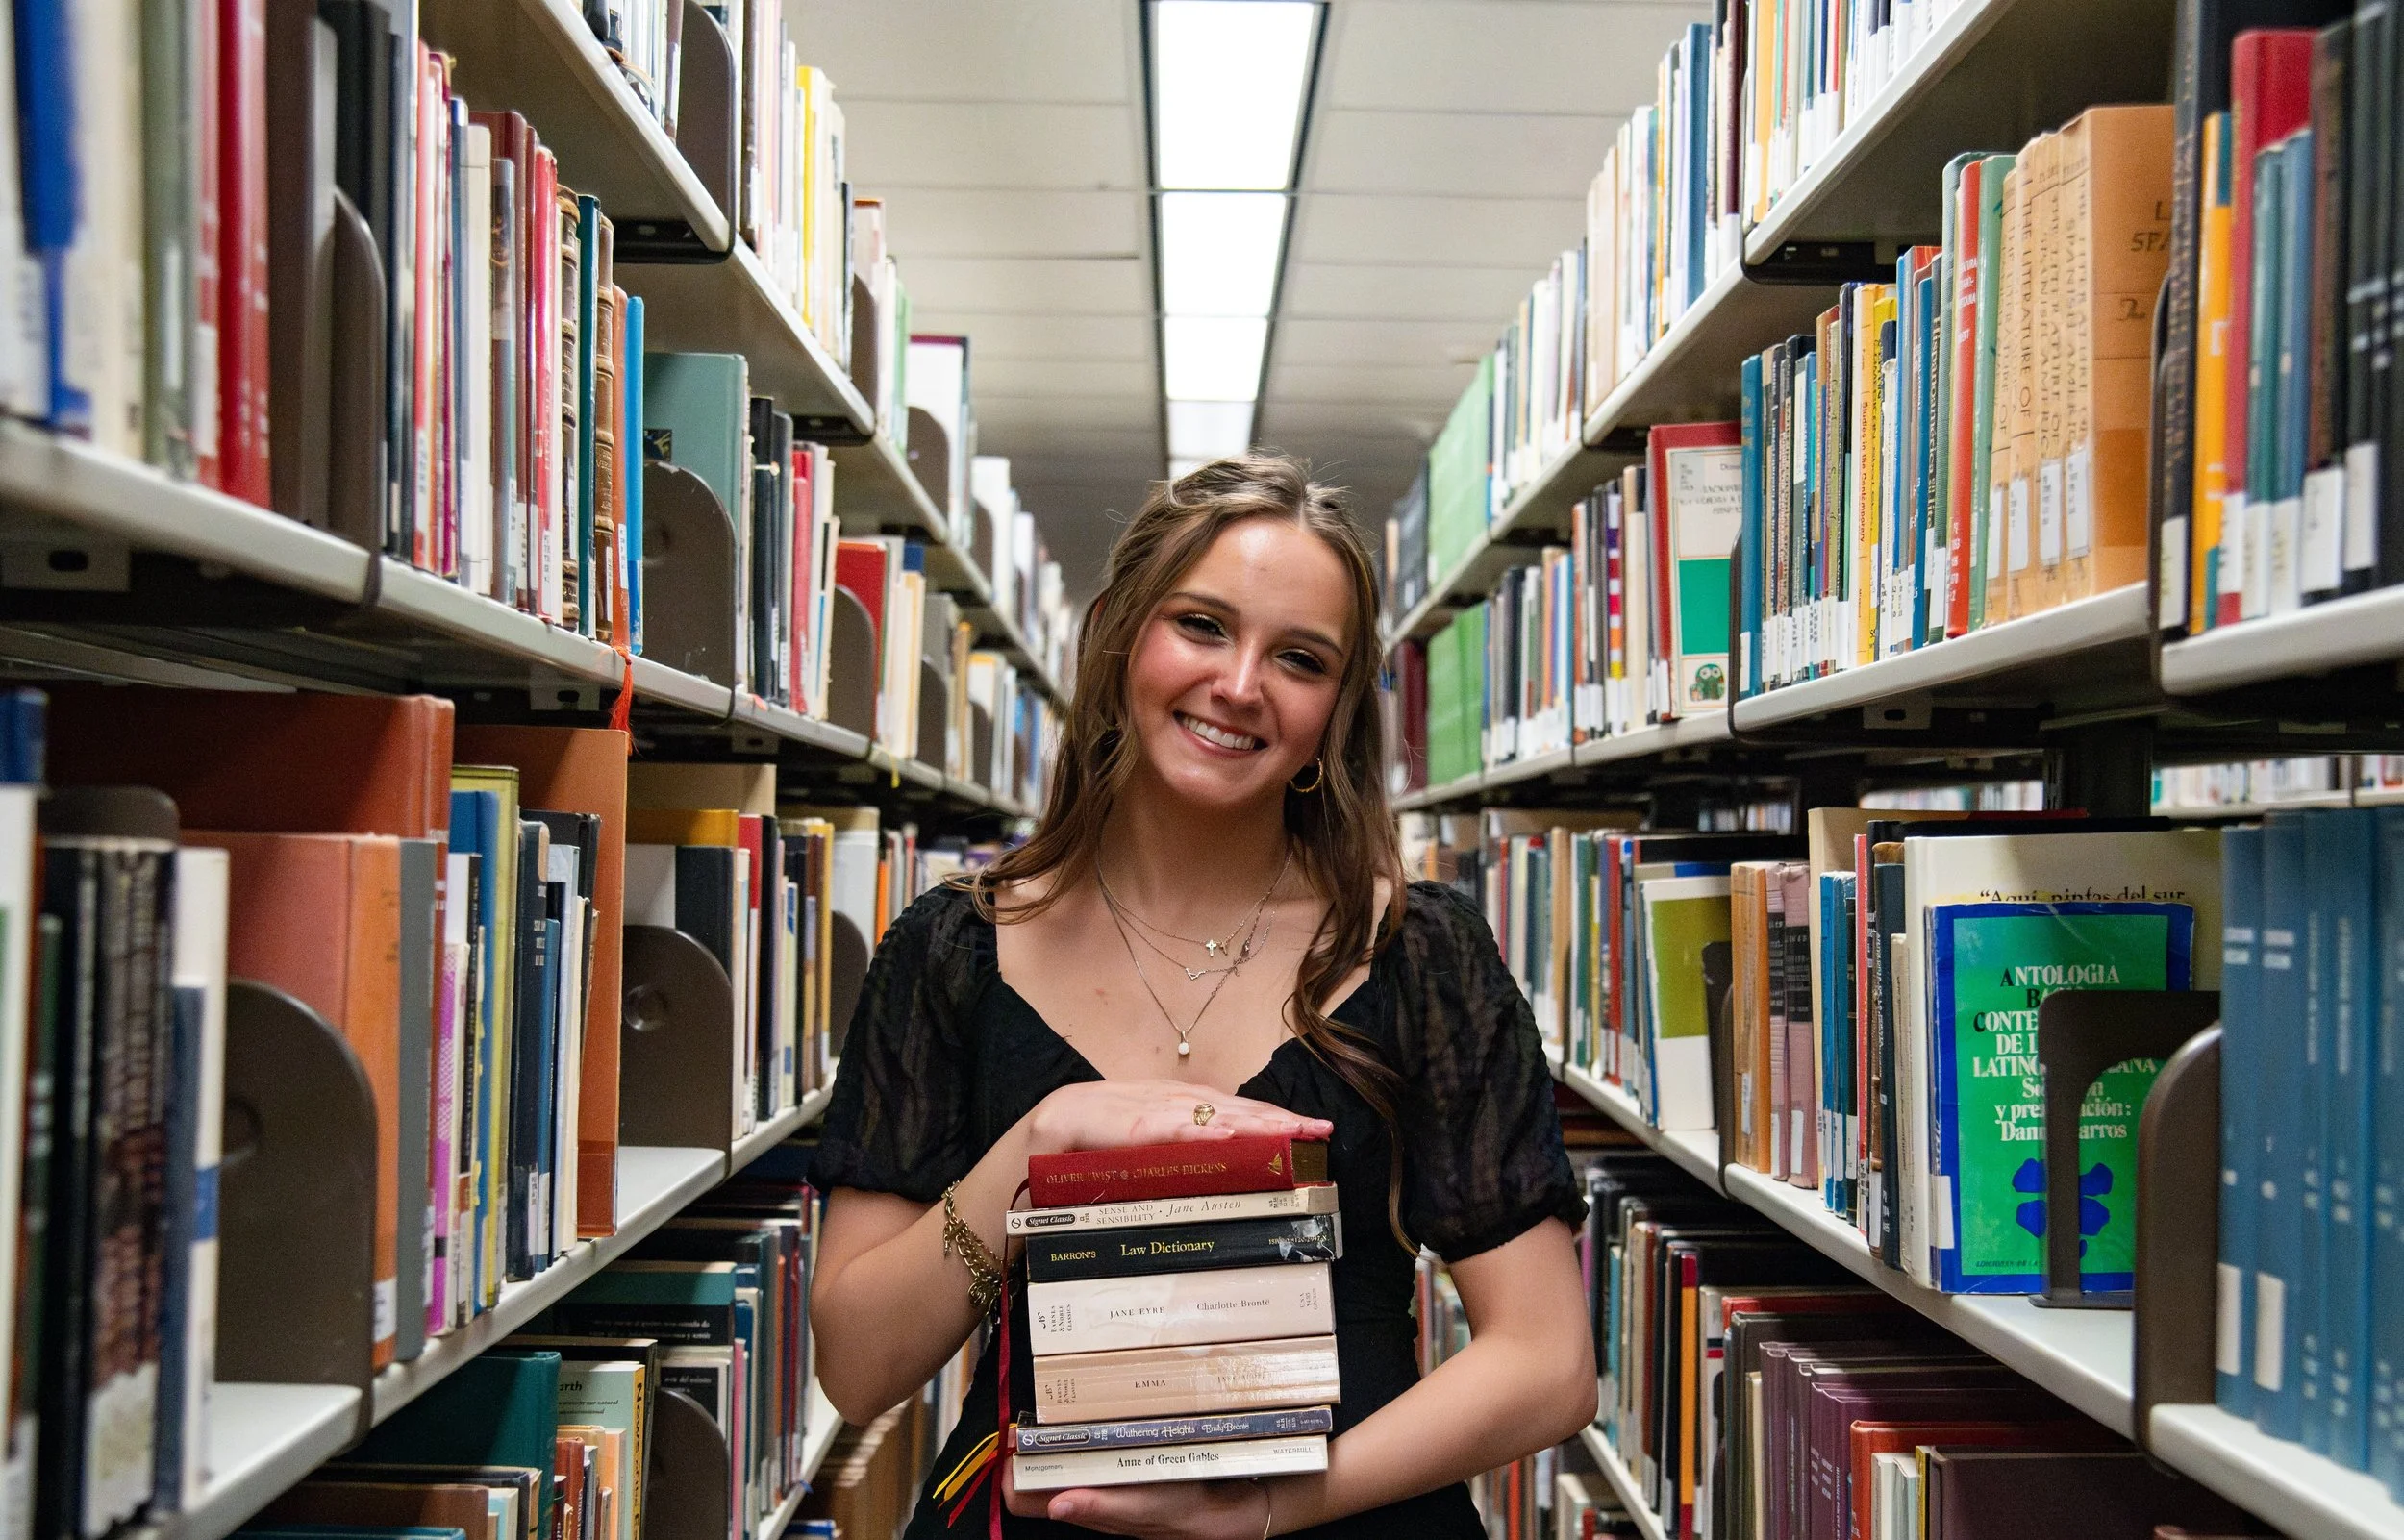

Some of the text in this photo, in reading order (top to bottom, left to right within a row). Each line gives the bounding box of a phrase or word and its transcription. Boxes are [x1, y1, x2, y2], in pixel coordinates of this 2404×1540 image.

[2020, 386, 2032, 419] OF
[1861, 439, 1866, 451] in
[1858, 472, 1867, 542] Contemporary
[2000, 964, 2120, 987] ANTOLOGIA
[1996, 1034, 2023, 1055] DE
[1995, 1105, 2008, 1124] y
[1046, 1162, 1227, 1184] OLIVER TWIST CHARLES DICKENS
[1099, 1198, 1242, 1218] SENSE AND Jane Austen
[1029, 1217, 1049, 1226] Signet
[1096, 1213, 1156, 1225] SENSIBILITY
[1050, 1251, 1096, 1262] BARRON'S
[1120, 1244, 1147, 1256] Law
[1150, 1240, 1215, 1255] Dictionary
[1110, 1308, 1135, 1320] JANE
[1139, 1306, 1165, 1316] EYRE
[1196, 1300, 1238, 1311] Charlotte
[1135, 1379, 1166, 1389] EMMA
[1039, 1432, 1088, 1443] Signet Classic
[1113, 1427, 1159, 1438] Wuthering
[1161, 1425, 1196, 1437] Heights
[1201, 1423, 1224, 1433] Emily
[1117, 1456, 1142, 1468] Anne
[1145, 1455, 1155, 1465] of
[1158, 1453, 1186, 1464] Green
[1189, 1452, 1219, 1462] Gables
